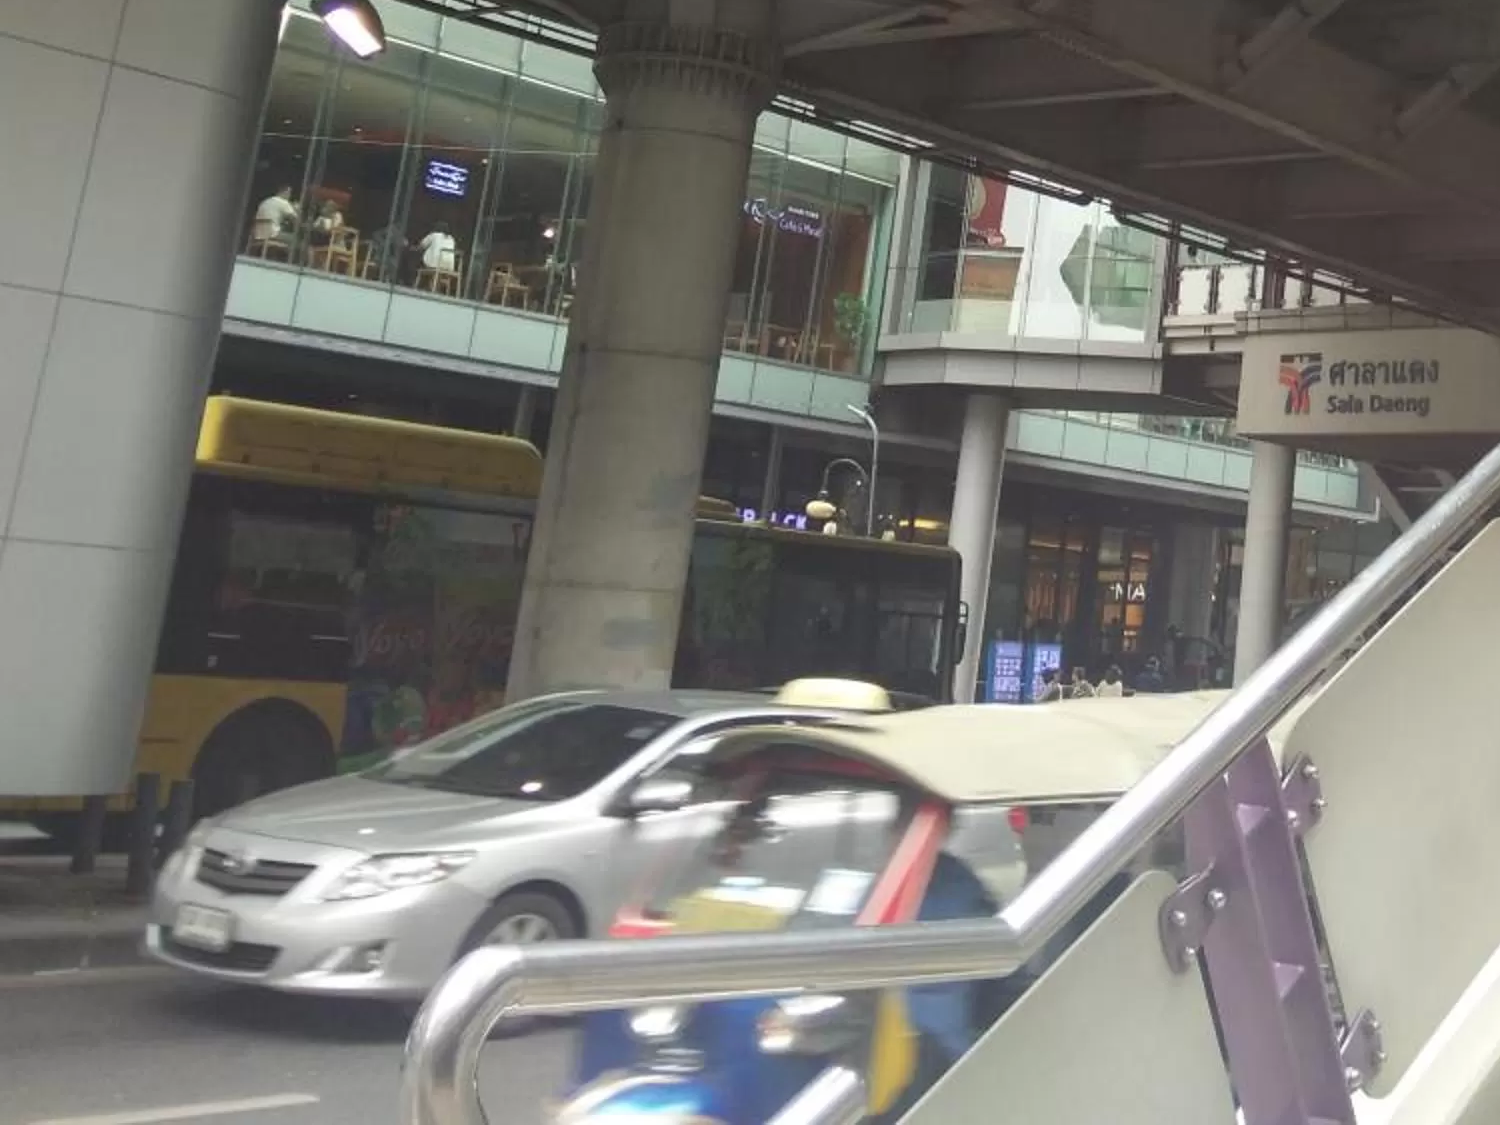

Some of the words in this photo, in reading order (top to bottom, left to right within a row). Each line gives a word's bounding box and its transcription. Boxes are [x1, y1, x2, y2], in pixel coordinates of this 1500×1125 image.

[1329, 359, 1440, 387] ศาลาแดง
[1327, 395, 1364, 414] Sala
[1370, 394, 1430, 417] Daeng
